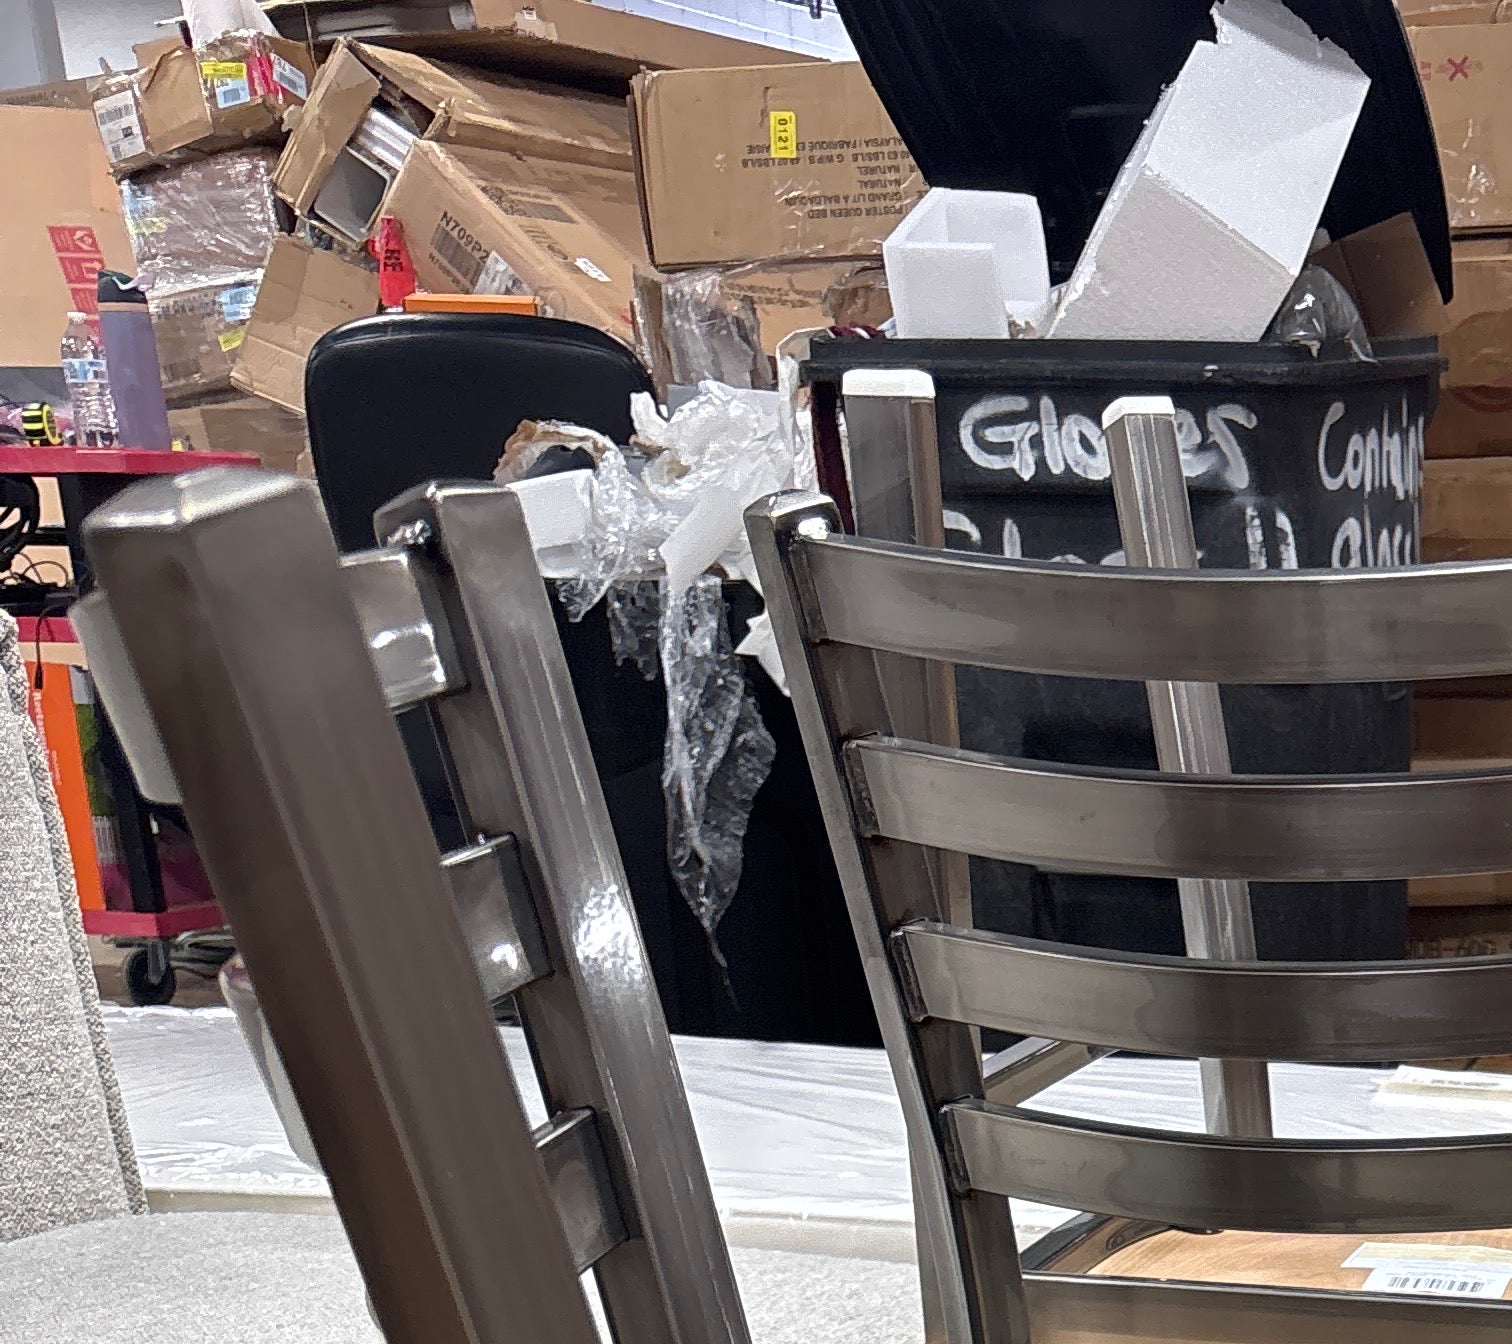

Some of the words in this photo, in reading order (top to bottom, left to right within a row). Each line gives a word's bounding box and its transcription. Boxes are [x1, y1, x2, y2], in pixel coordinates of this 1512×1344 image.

[777, 117, 789, 151] 0121
[863, 137, 903, 148] ALAYSIA
[959, 395, 1258, 489] Gloes
